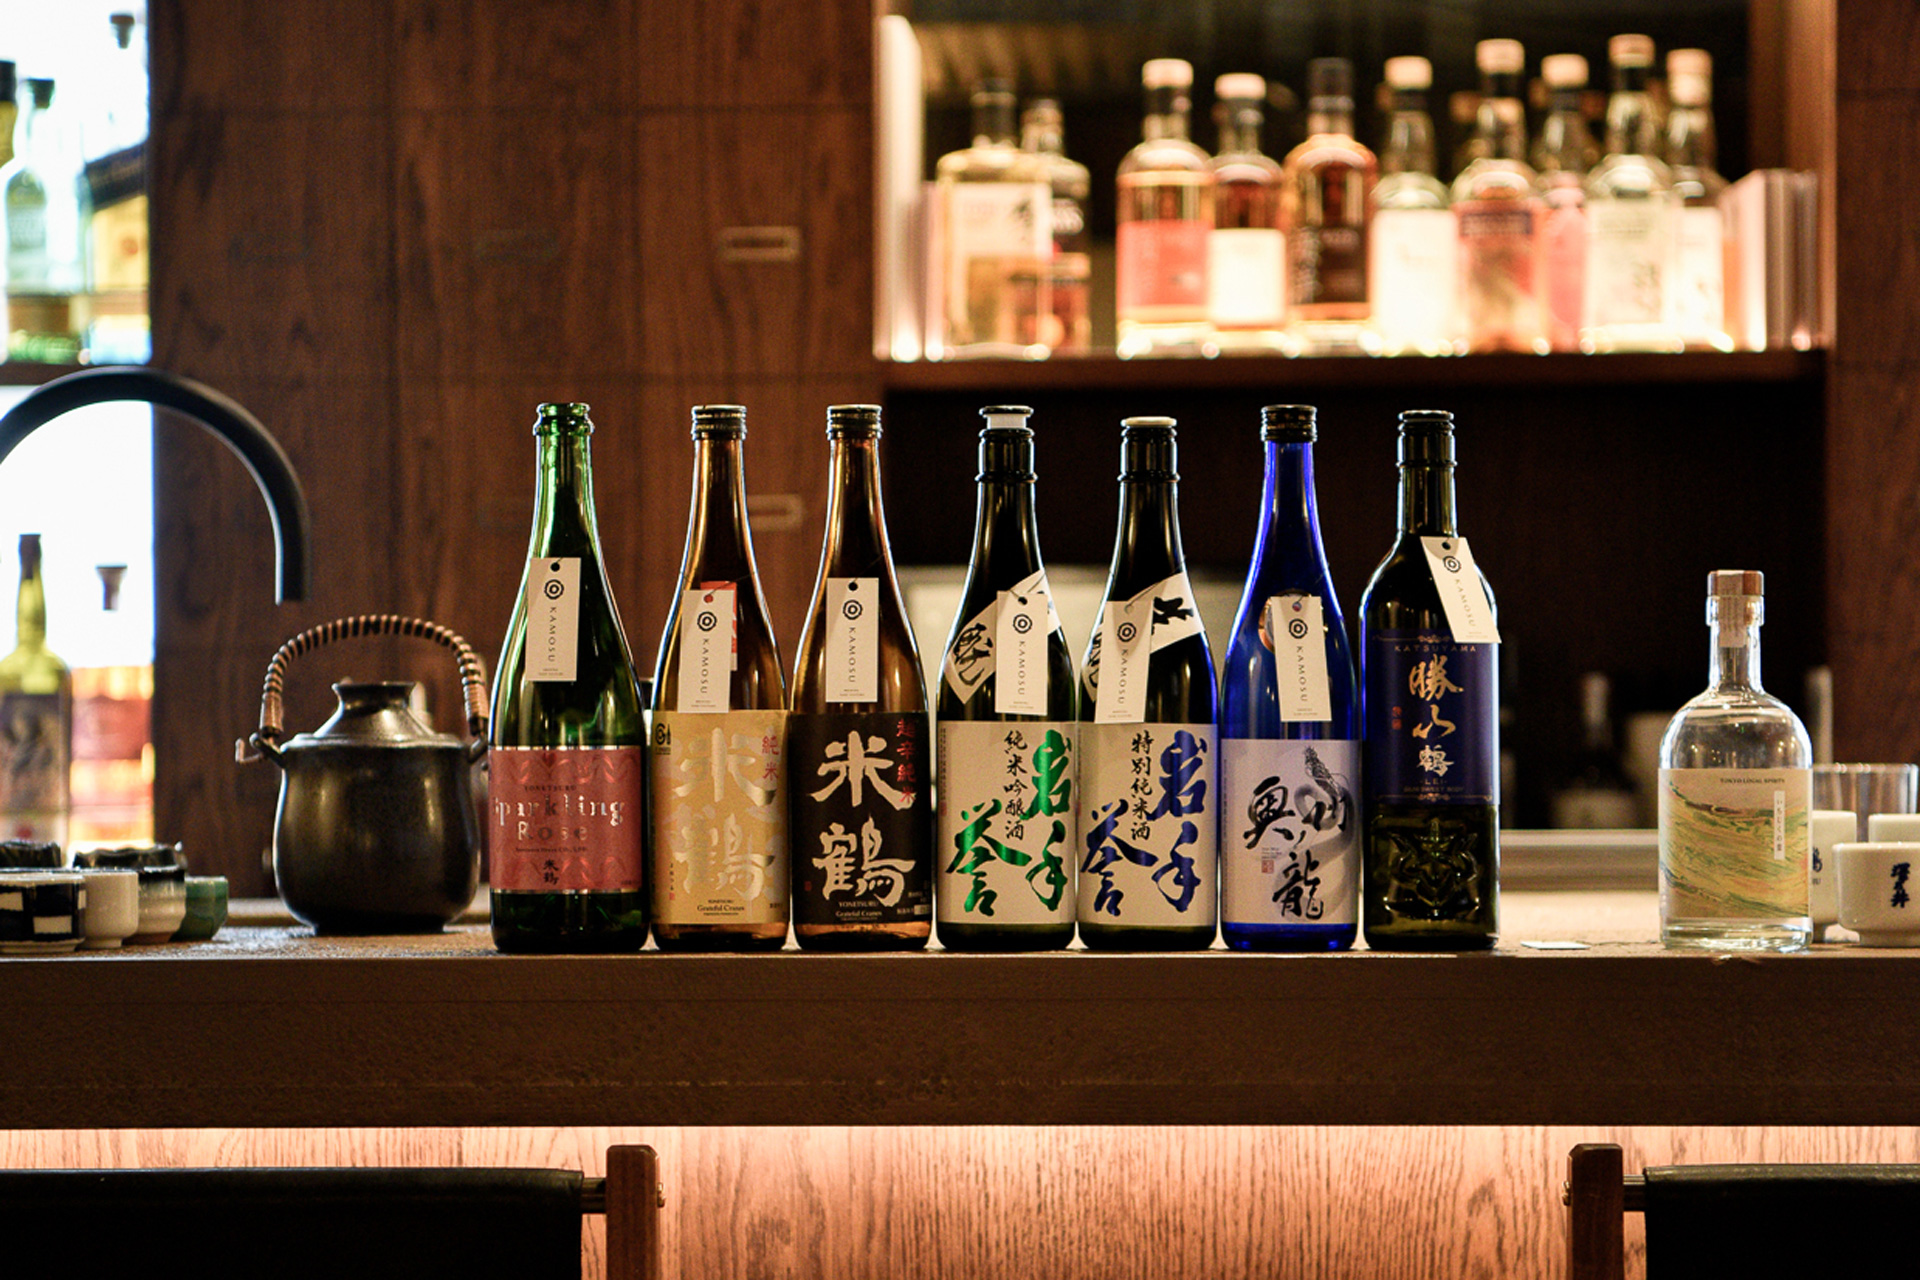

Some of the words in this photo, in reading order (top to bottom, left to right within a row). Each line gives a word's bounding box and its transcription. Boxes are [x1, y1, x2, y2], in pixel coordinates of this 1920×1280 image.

[1455, 578, 1475, 627] KAMOSU
[548, 606, 557, 663] KAMOSU
[848, 626, 857, 683] KAMOSU
[1394, 645, 1477, 653] KATSUYAMA
[700, 638, 710, 695] KAMOSU
[1017, 640, 1026, 696] KAMOSU
[1118, 649, 1128, 705] KAMOSU
[1296, 645, 1308, 703] KAMOSU
[761, 735, 781, 781] 純米
[1130, 729, 1154, 841] 特別純米酒
[517, 820, 588, 841] Rose
[810, 730, 917, 907] 米鶴
